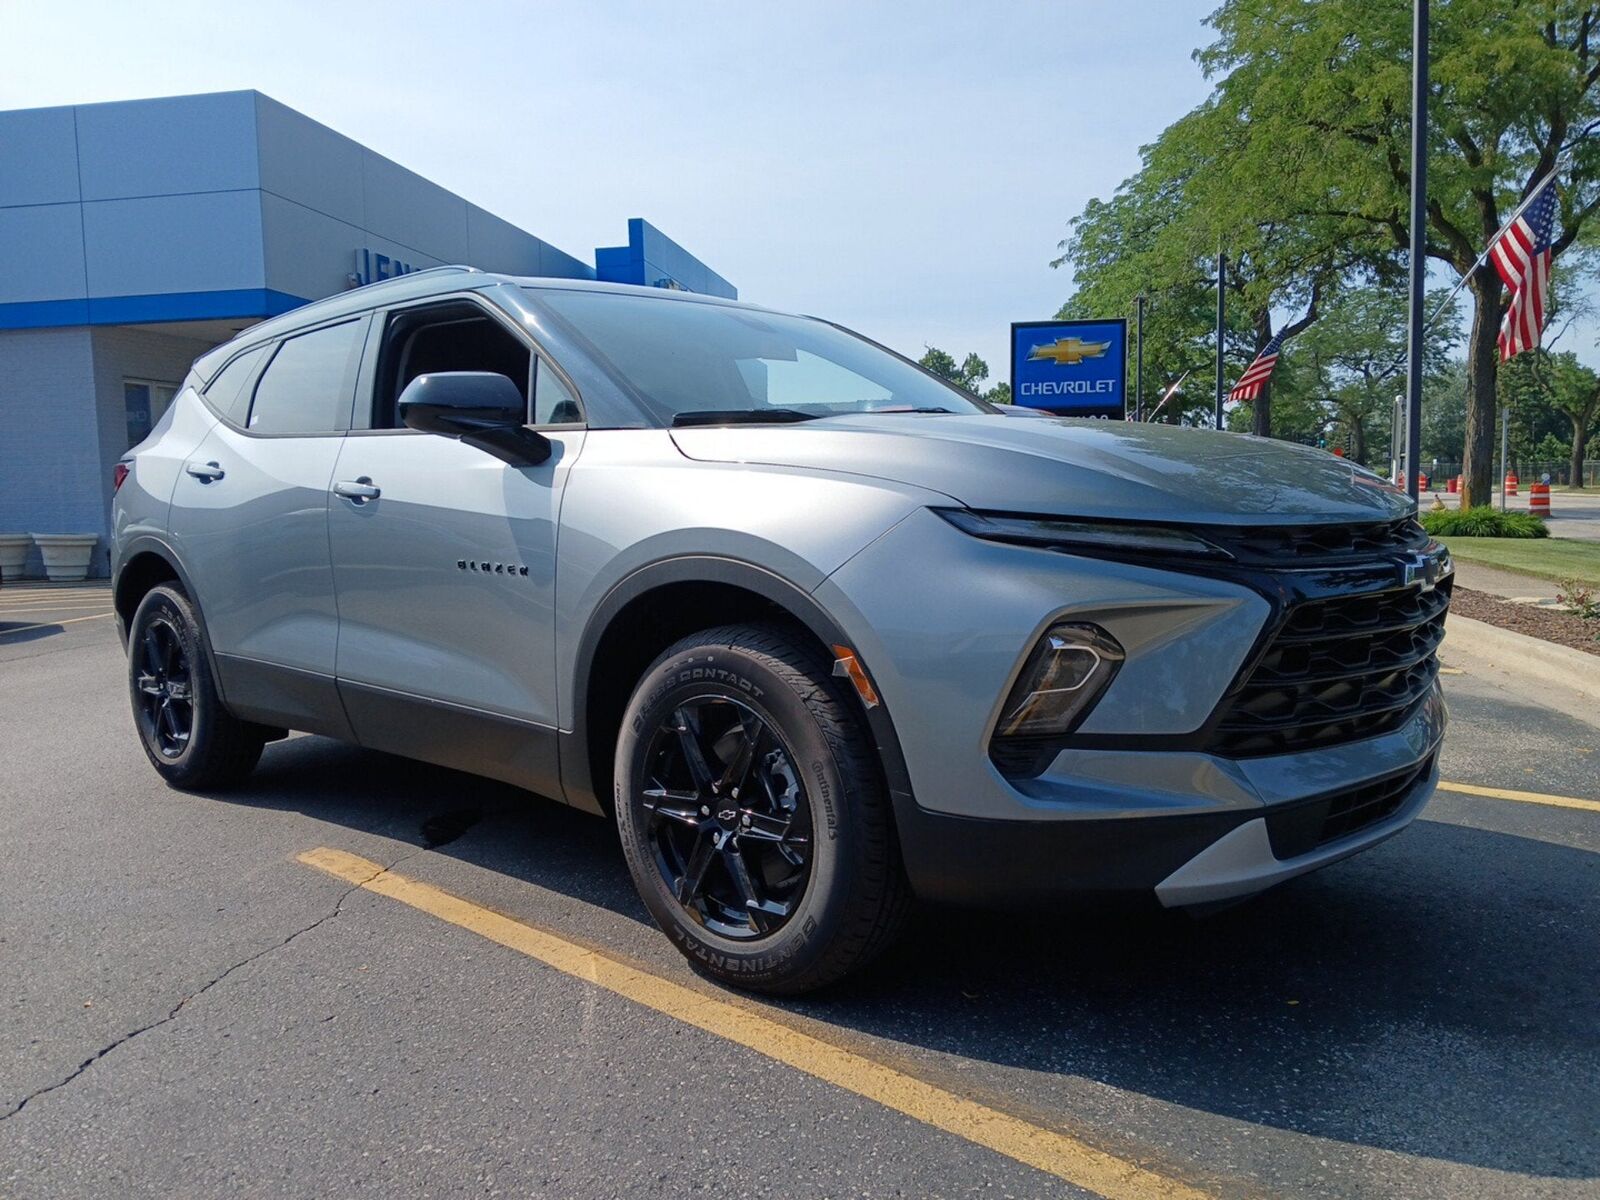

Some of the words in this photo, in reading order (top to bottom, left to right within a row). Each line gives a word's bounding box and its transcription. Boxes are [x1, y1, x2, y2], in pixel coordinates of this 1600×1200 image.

[1020, 380, 1116, 396] CHEVROLET
[457, 560, 529, 577] BLAZER
[679, 668, 765, 697] CONTACT
[674, 914, 817, 972] CONTINENTAL
